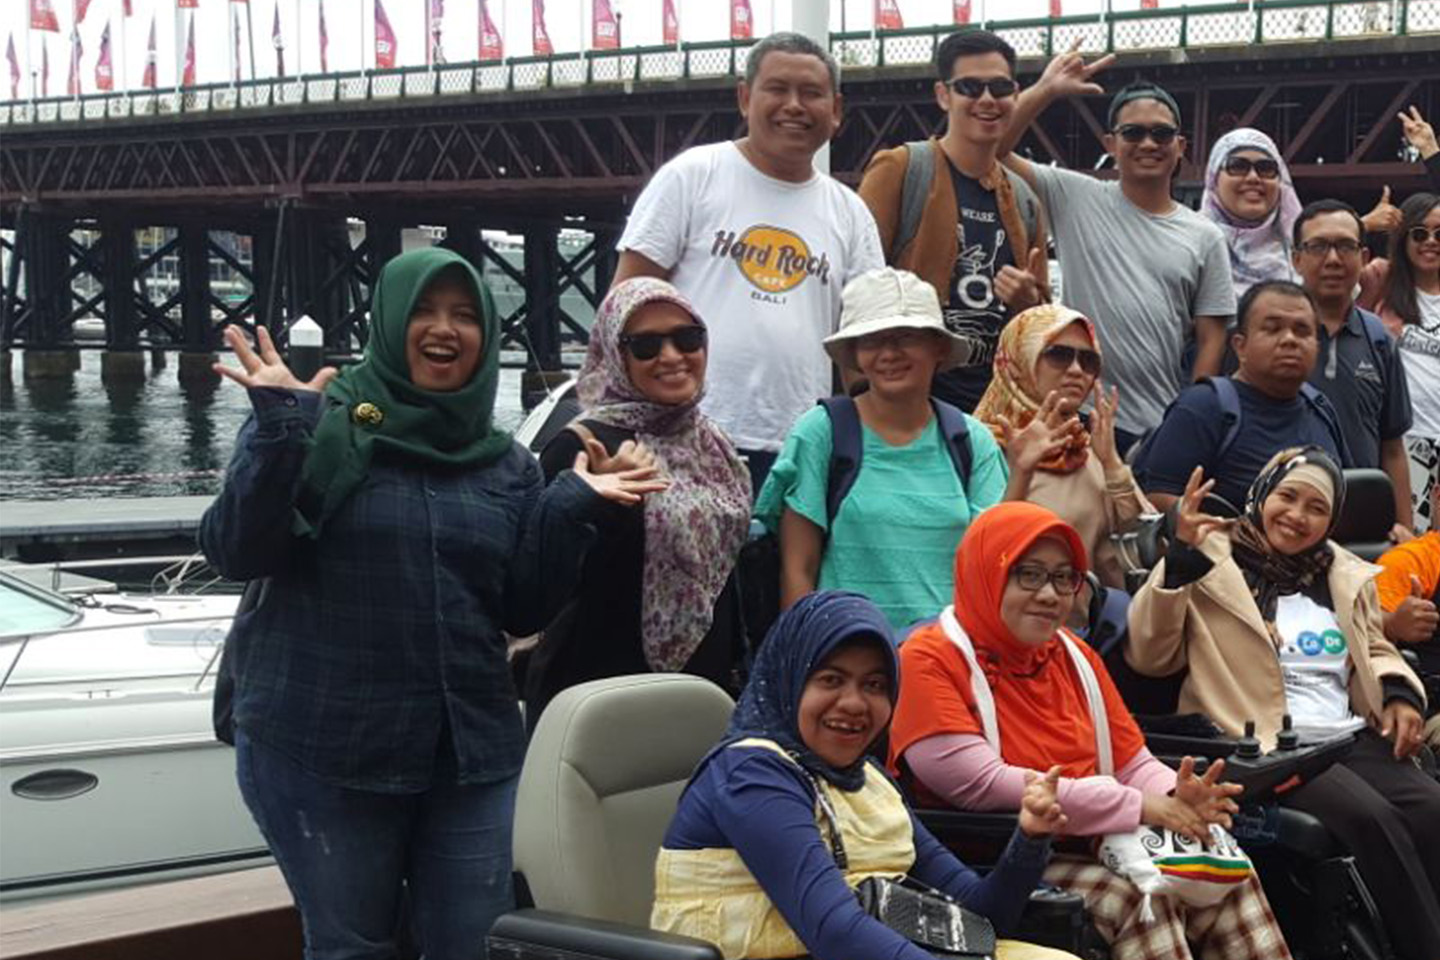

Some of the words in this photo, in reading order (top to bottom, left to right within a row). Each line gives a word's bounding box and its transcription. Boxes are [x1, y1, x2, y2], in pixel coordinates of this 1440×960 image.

[711, 230, 772, 268] Hard
[777, 245, 830, 285] Rock
[750, 291, 786, 305] BALI
